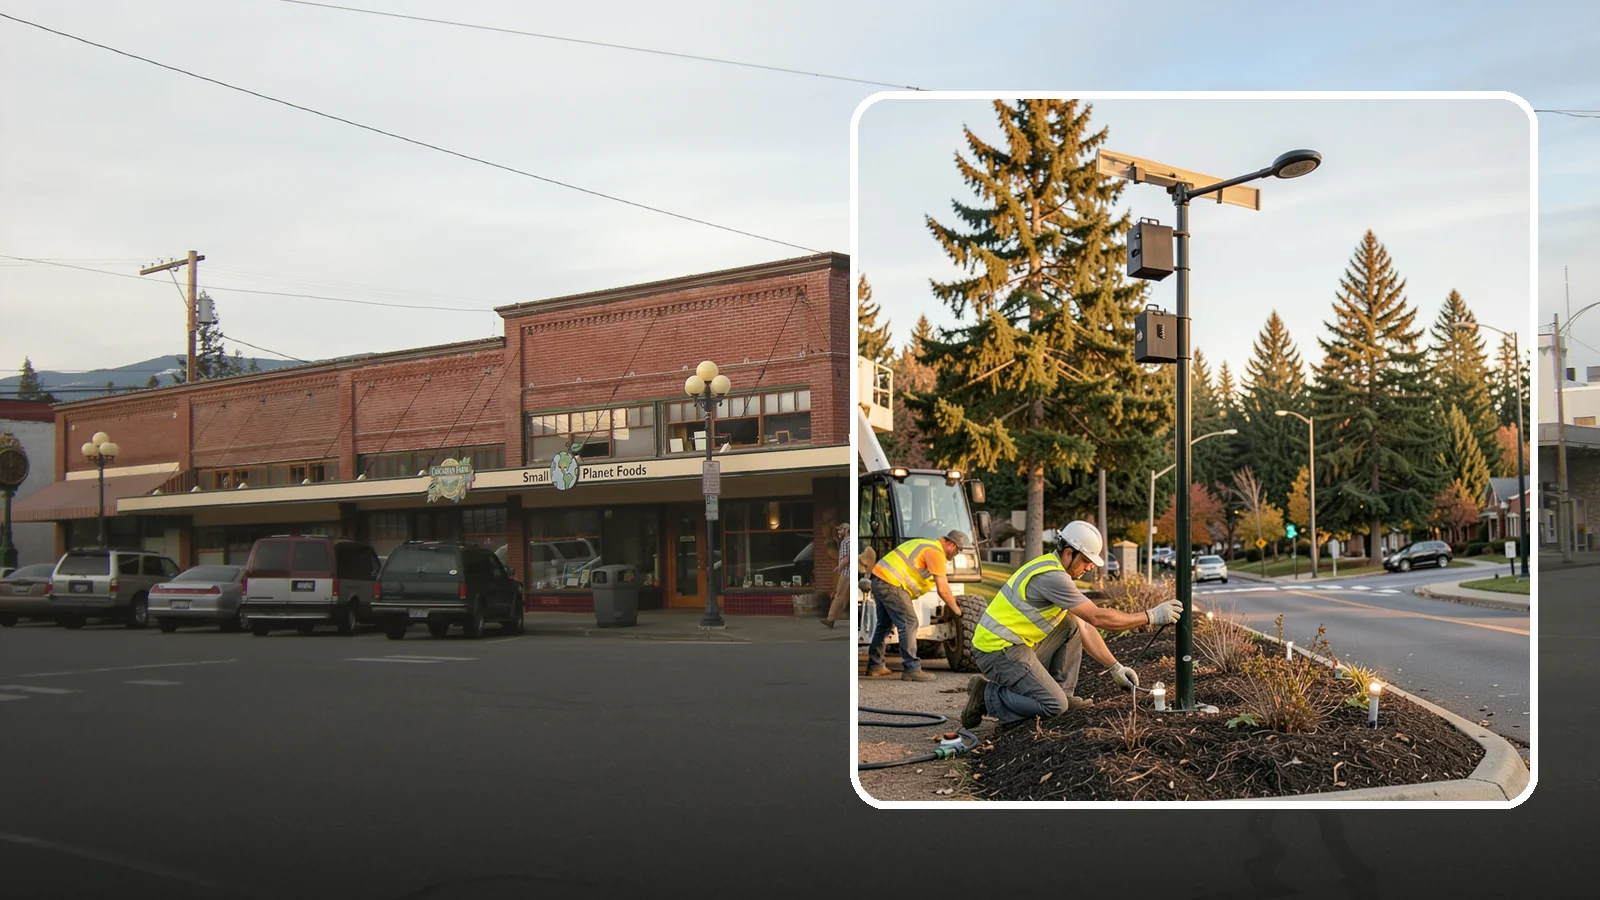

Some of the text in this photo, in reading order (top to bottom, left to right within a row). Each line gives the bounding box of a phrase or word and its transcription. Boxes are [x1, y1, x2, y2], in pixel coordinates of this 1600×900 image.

[431, 466, 456, 476] CASCADIAN
[522, 464, 647, 483] Small Planet Foods
